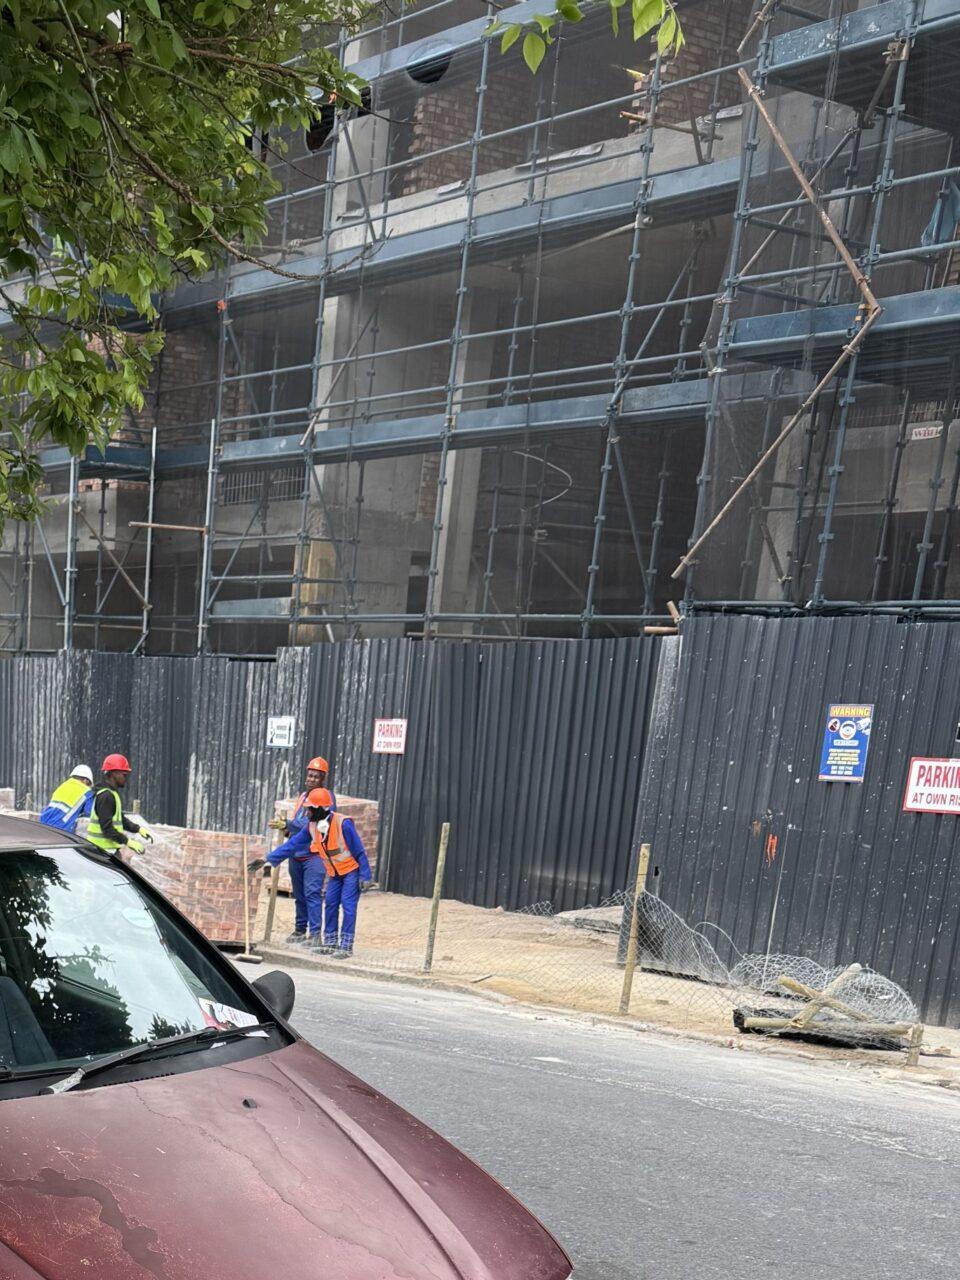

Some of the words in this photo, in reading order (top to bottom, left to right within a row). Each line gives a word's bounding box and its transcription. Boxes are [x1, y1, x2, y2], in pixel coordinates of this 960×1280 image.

[831, 707, 870, 717] WARNING
[377, 724, 403, 738] PARKING
[916, 765, 960, 788] PARKIN
[912, 792, 924, 804] AT
[925, 793, 947, 805] OWN
